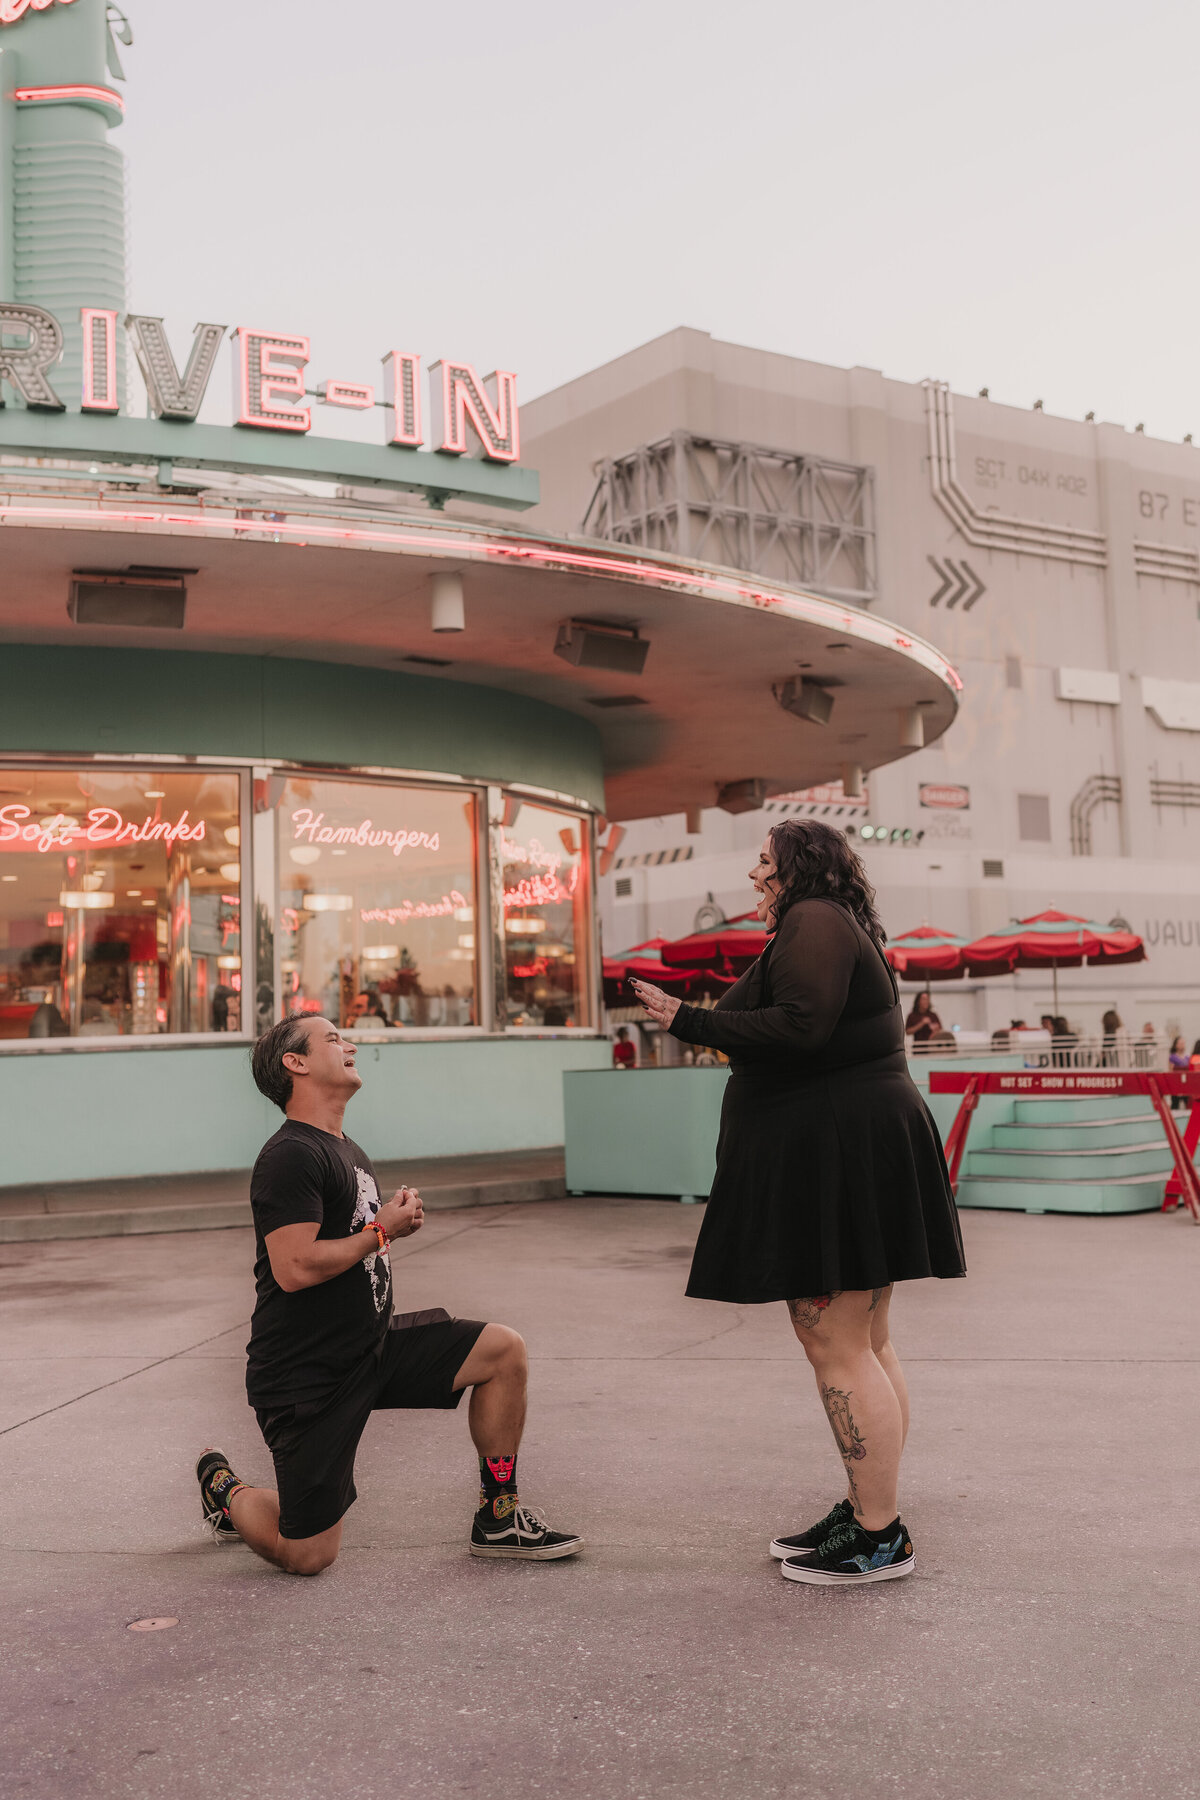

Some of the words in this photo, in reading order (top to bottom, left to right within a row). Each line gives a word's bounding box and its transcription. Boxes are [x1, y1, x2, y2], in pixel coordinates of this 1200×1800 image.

[1139, 490, 1170, 522] 87
[1182, 497, 1200, 528] E
[0, 804, 80, 852] Soft
[87, 807, 206, 842] Drinks
[291, 808, 440, 856] Hamburgers
[1017, 1076, 1033, 1088] SET
[1041, 1076, 1064, 1088] SHOW
[1065, 1076, 1075, 1088] IN
